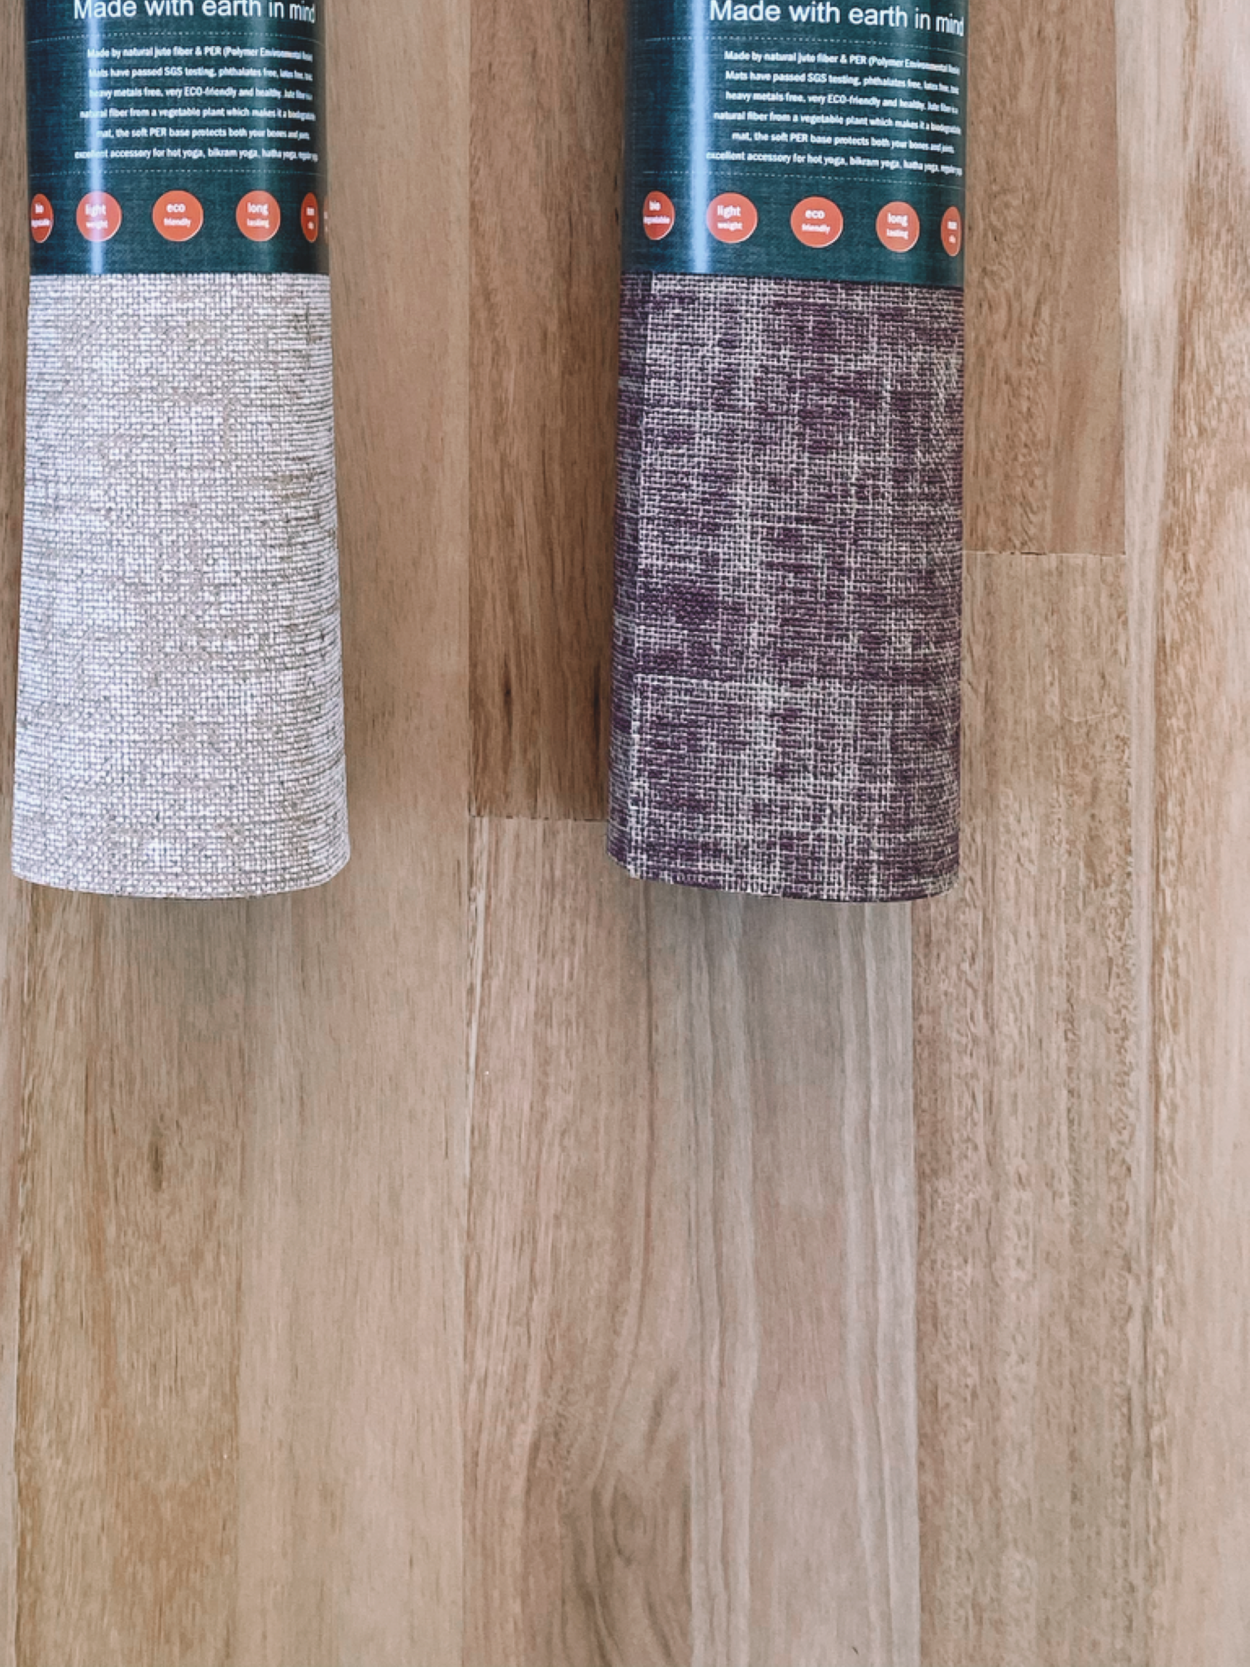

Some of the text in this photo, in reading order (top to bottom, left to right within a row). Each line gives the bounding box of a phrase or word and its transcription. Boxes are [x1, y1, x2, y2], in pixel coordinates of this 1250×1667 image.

[289, 0, 315, 24] mind
[709, 0, 964, 37] Made with earth in mind
[724, 50, 797, 63] Made by natural
[165, 89, 183, 99] very
[184, 86, 237, 99] ECO-friendly
[238, 88, 254, 97] and
[130, 107, 150, 117] from
[158, 107, 200, 119] vegetable
[202, 107, 225, 119] plant
[226, 107, 250, 117] which
[149, 127, 248, 139] PER base protects both
[771, 132, 890, 147] soft PER base protects both
[747, 152, 791, 164] accessory
[792, 153, 806, 163] for
[807, 153, 823, 164] hot
[85, 203, 106, 217] light
[166, 203, 186, 213] eco
[247, 202, 268, 216] long
[717, 205, 741, 219] light
[805, 210, 825, 220] eco
[887, 213, 908, 227] long
[163, 217, 191, 227] friendly
[247, 218, 269, 229] lasting
[717, 221, 742, 231] weight
[802, 223, 830, 234] friendly
[886, 228, 908, 240] lasting
